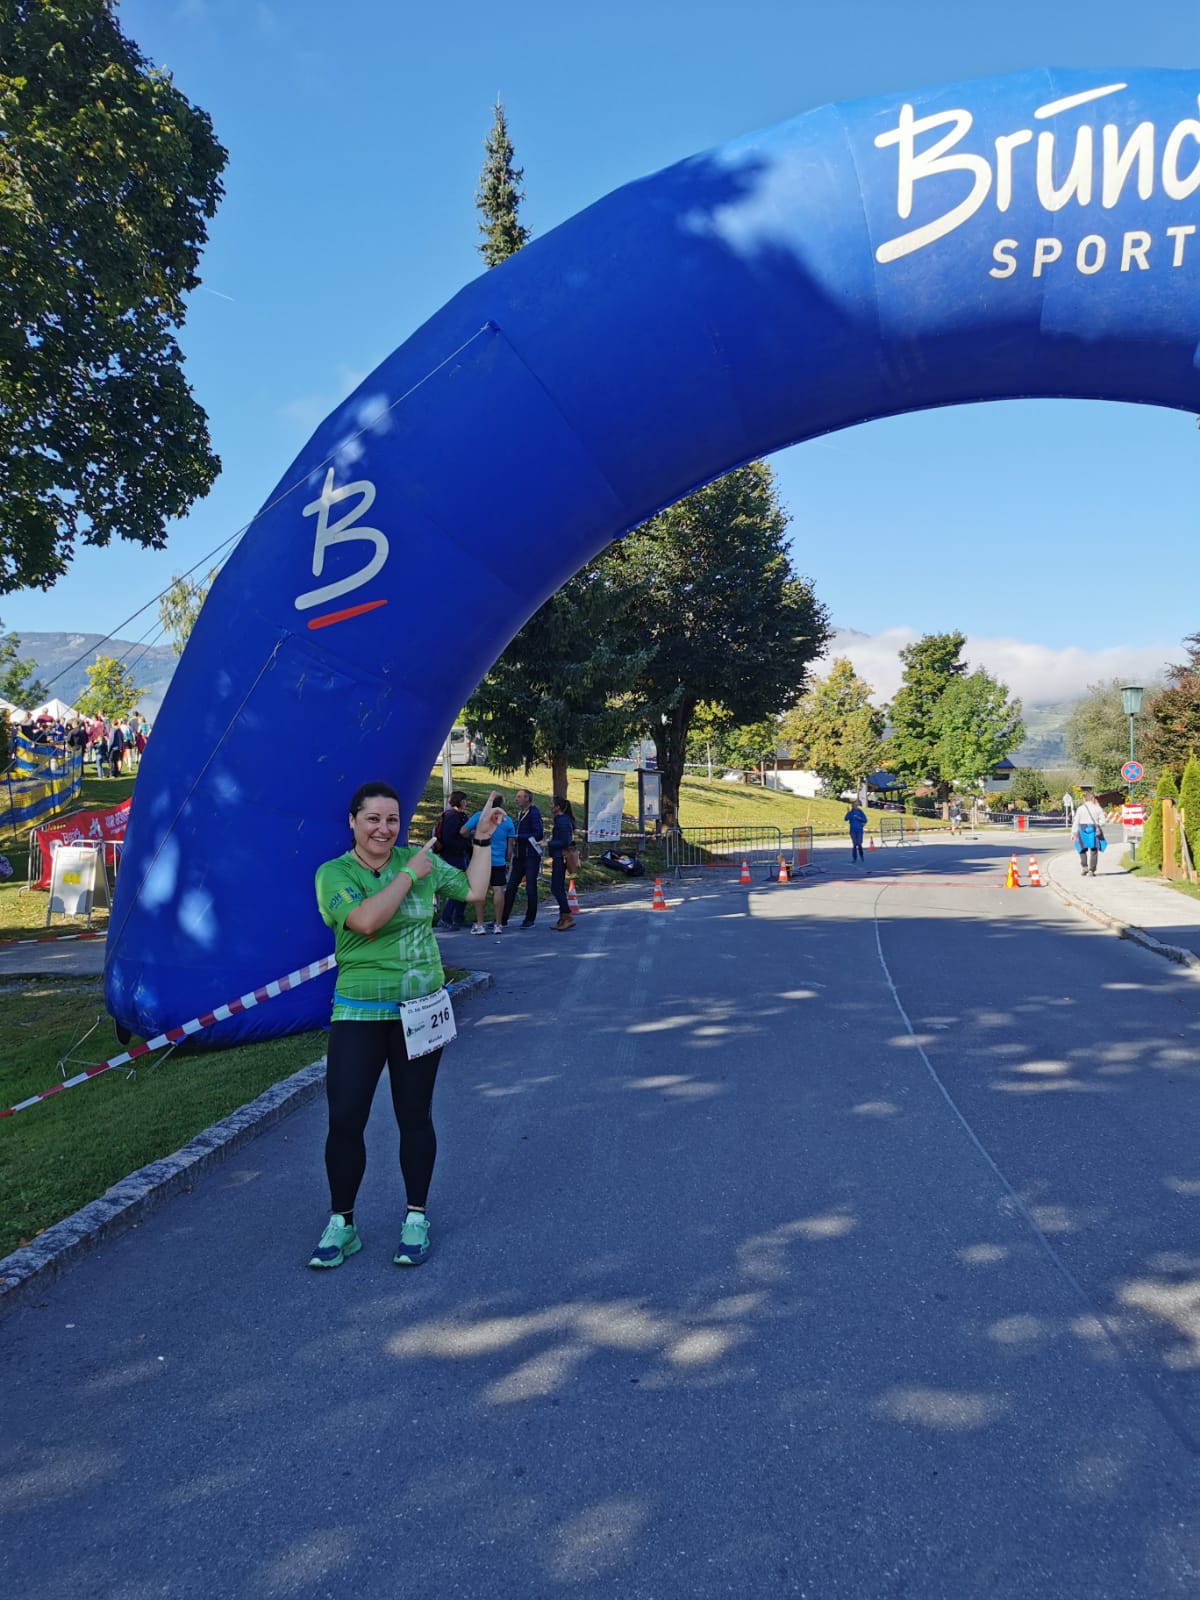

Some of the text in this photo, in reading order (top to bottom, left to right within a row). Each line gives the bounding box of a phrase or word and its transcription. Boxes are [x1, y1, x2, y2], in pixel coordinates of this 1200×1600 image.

[988, 225, 1197, 278] SPORT
[294, 466, 389, 611] B
[430, 1006, 450, 1029] 216
